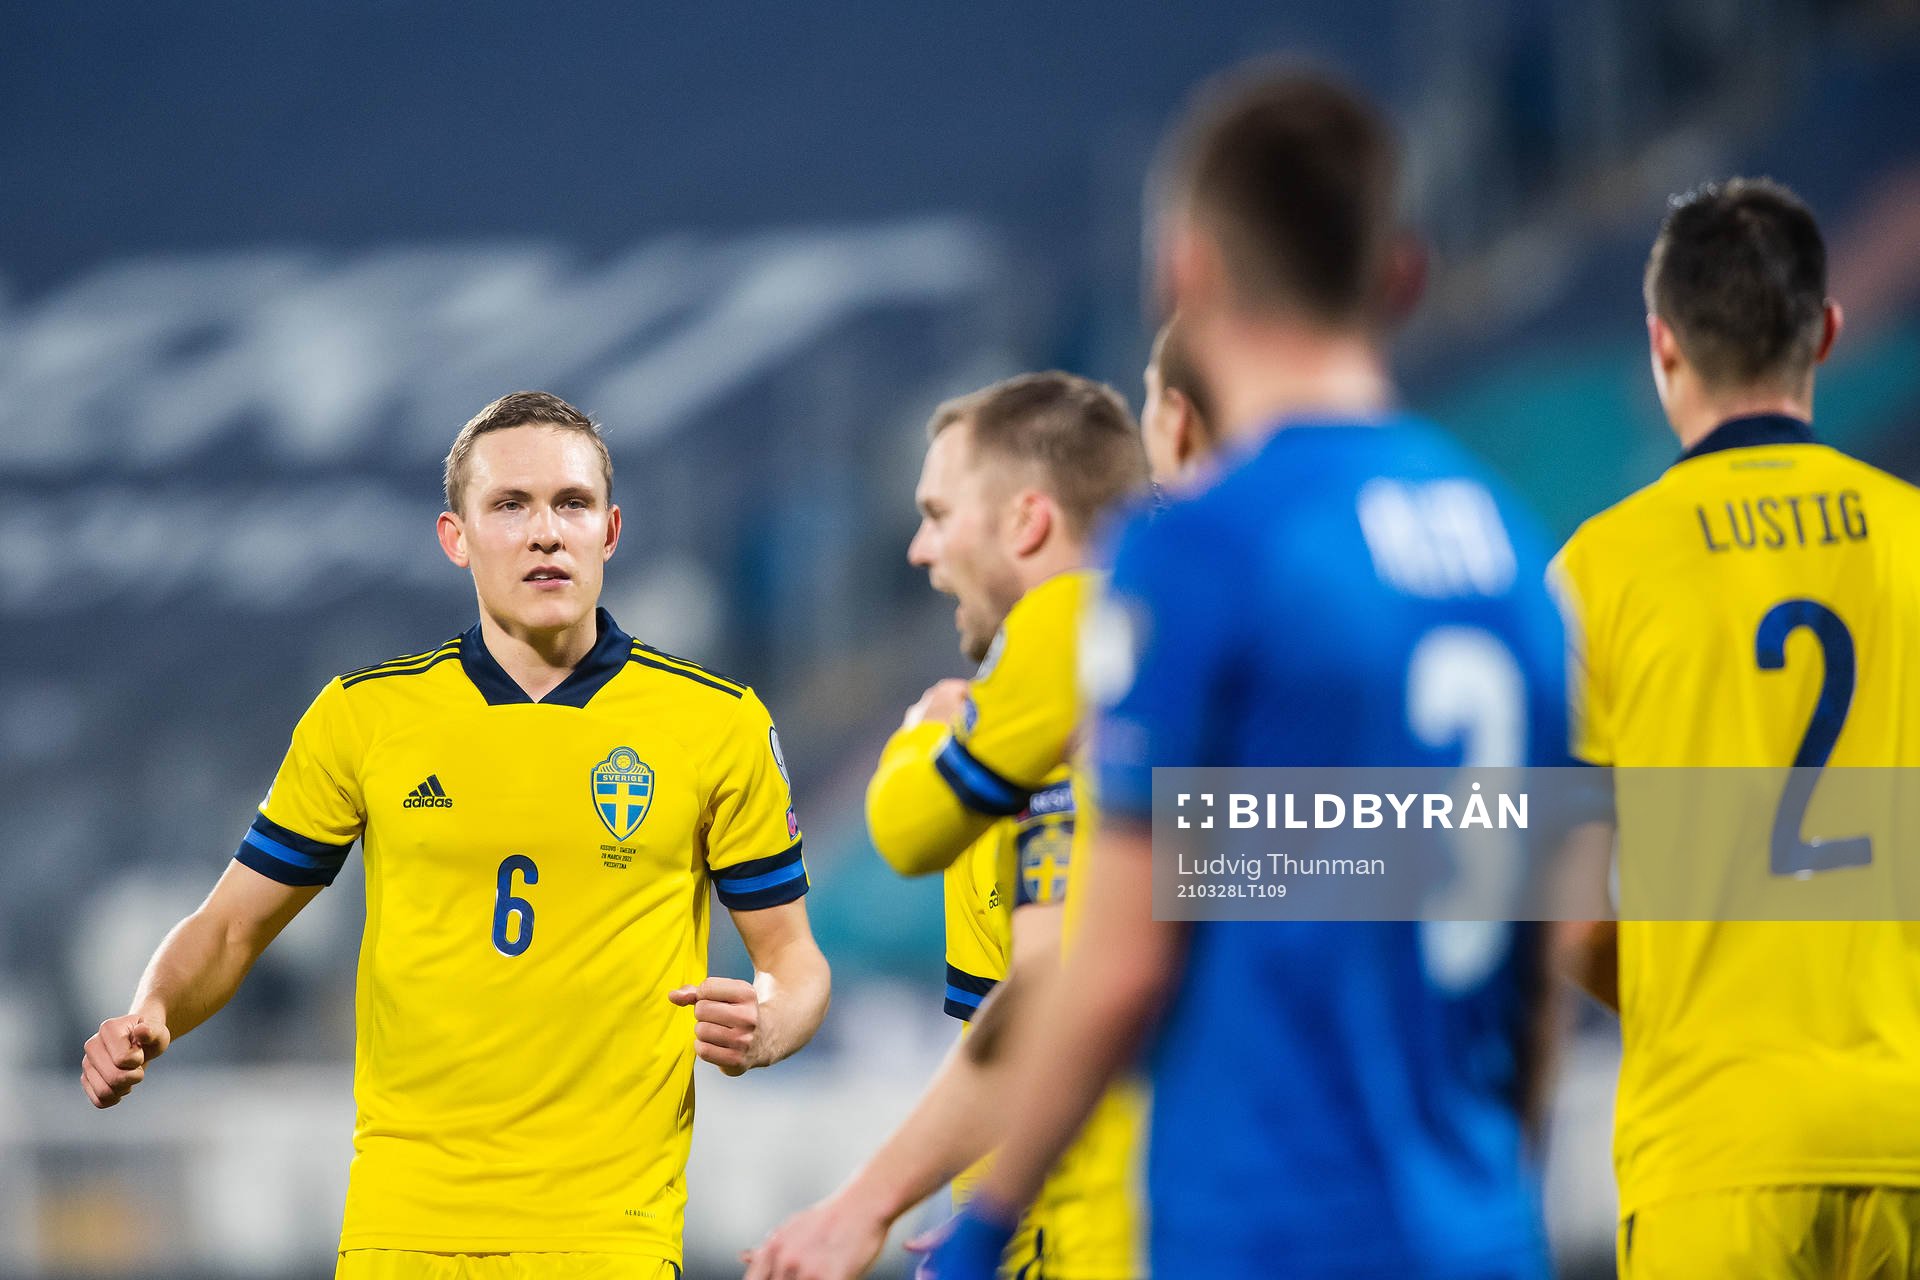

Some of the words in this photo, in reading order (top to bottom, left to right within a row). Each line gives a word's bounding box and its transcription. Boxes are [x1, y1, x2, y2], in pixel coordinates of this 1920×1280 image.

[1696, 490, 1867, 552] LUSTIG
[1754, 597, 1872, 876] 2
[403, 795, 453, 808] adidas
[602, 774, 644, 783] SVERIGE
[492, 854, 538, 957] 6
